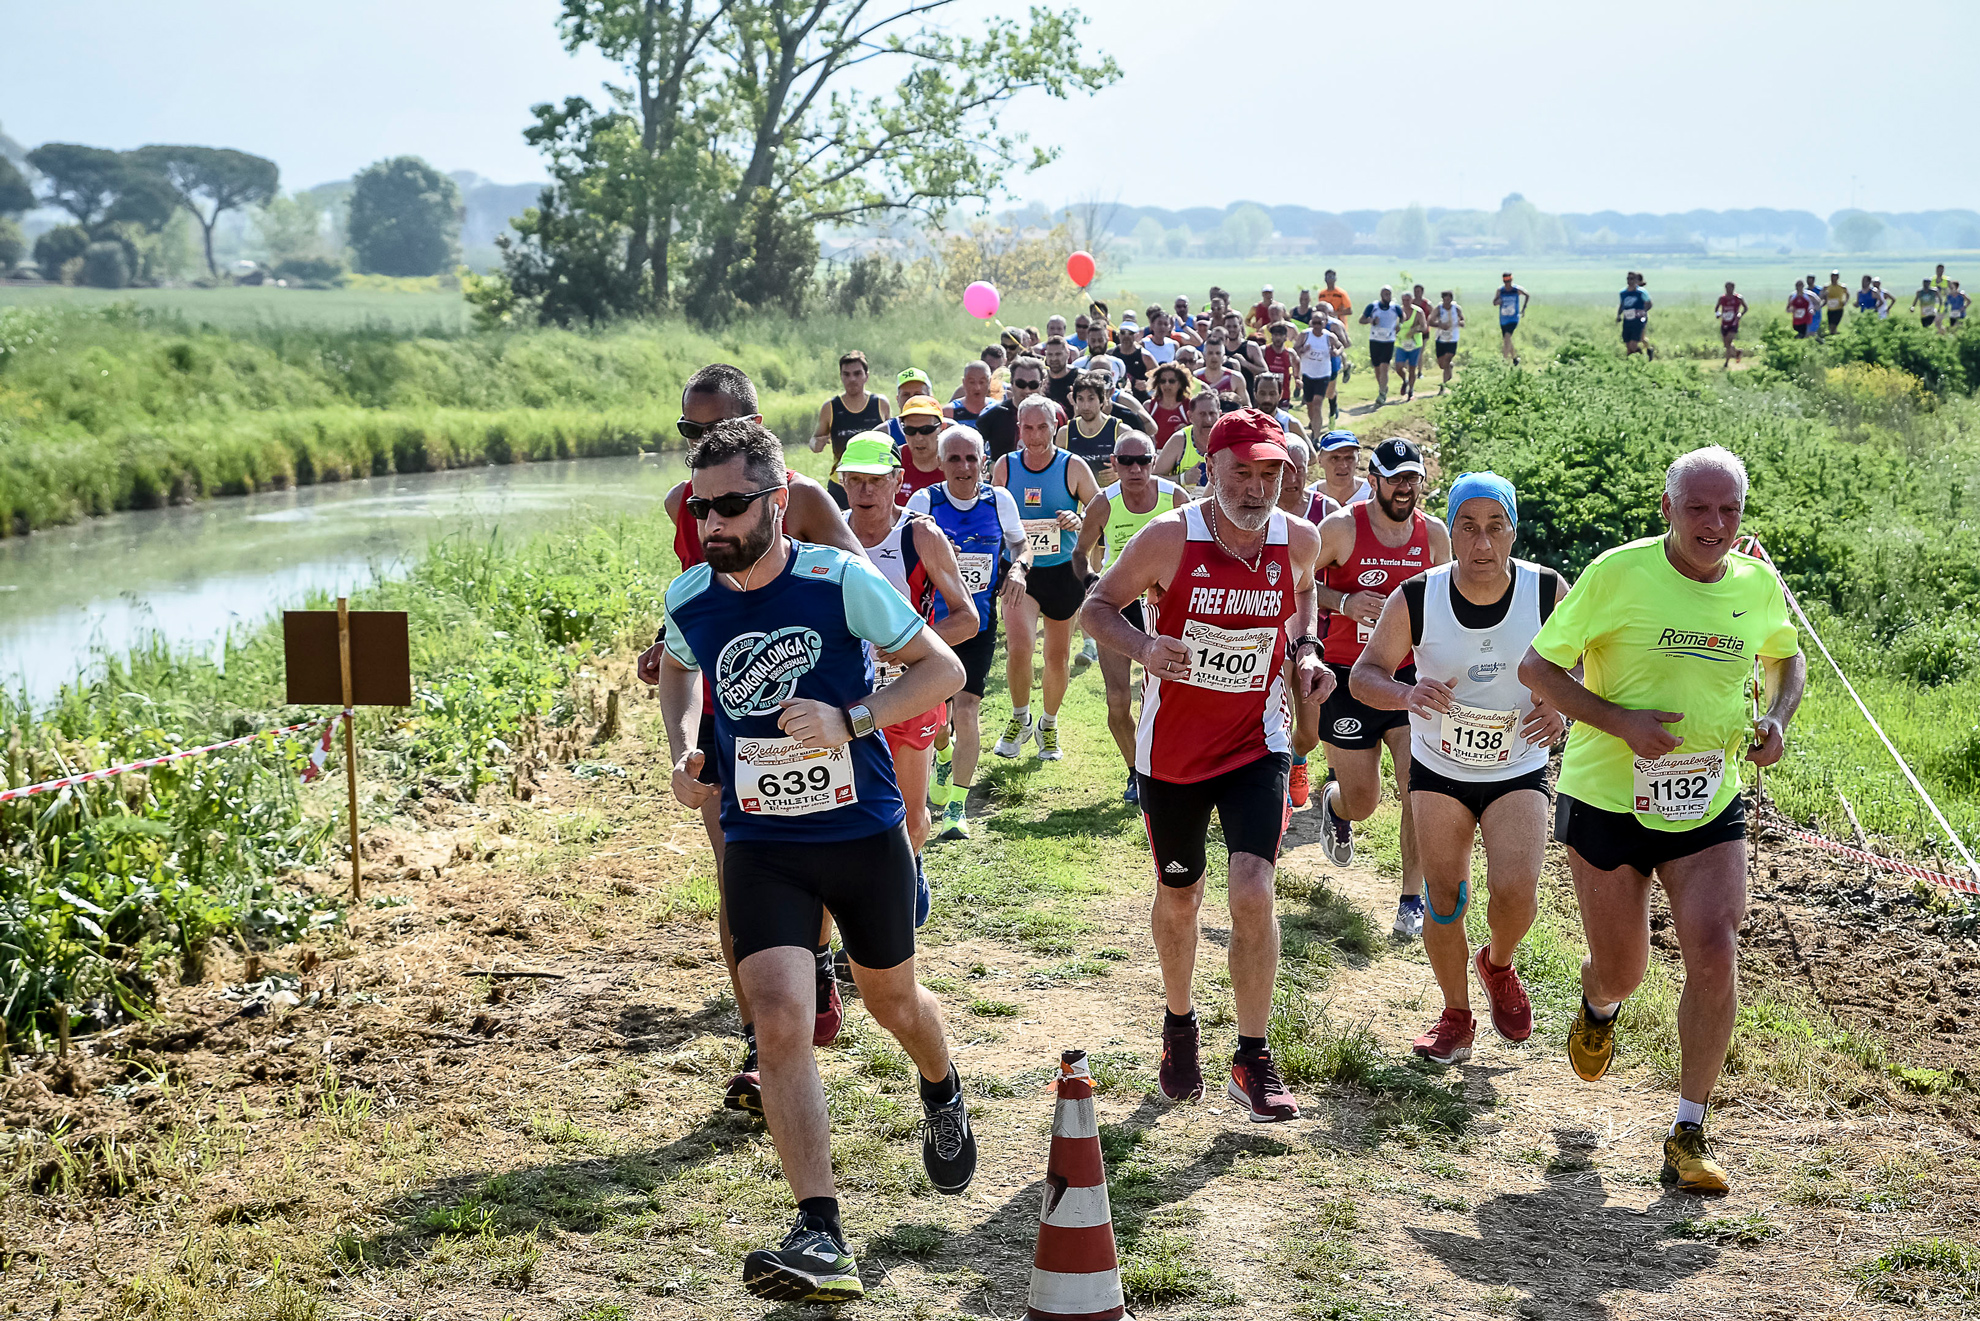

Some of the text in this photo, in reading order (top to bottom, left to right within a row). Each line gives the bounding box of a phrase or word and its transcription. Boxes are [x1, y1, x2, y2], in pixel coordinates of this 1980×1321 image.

[1027, 534, 1050, 546] 74
[1401, 559, 1422, 567] Runners
[960, 570, 981, 584] 53
[1188, 587, 1283, 617] FREE RUNNERS
[1185, 625, 1271, 643] Pedagnalonga
[720, 638, 755, 673] 22 APRILE 2018
[1197, 648, 1257, 674] 1400
[723, 636, 805, 707] PEDAGNALONGA
[768, 655, 809, 681] BORGO HERMADA
[1193, 671, 1248, 684] ATHLETICS
[759, 683, 790, 709] HALF MARATHON
[1453, 726, 1503, 750] 1138
[738, 742, 804, 764] Pedagna
[1634, 754, 1719, 773] Pedagnalonga
[757, 765, 831, 797] 639
[1648, 776, 1708, 801] 1132
